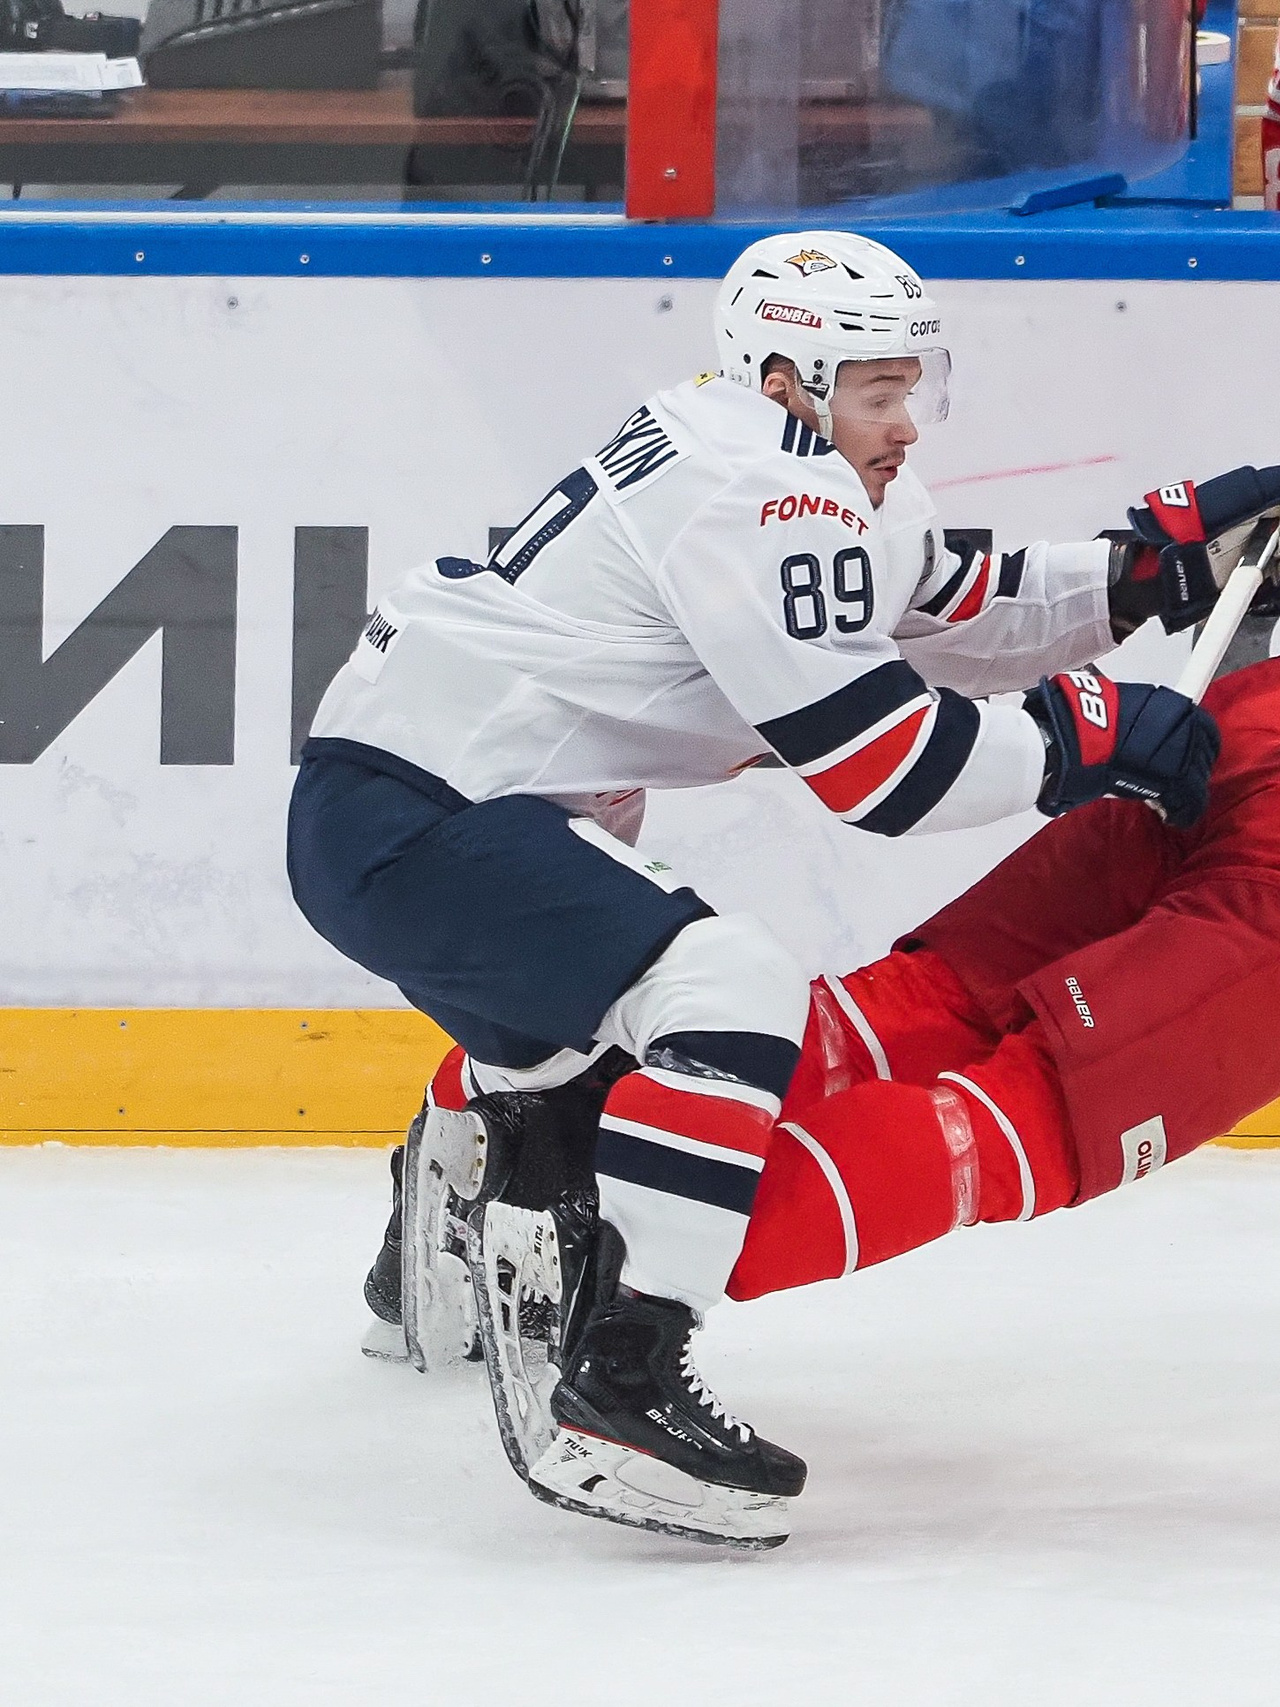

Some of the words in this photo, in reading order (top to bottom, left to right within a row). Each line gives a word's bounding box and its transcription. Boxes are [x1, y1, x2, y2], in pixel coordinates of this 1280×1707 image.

[764, 302, 823, 329] FONBET
[909, 319, 941, 338] cora
[759, 493, 870, 537] FONBET
[779, 545, 876, 641] 89
[1064, 976, 1096, 1029] BAUER
